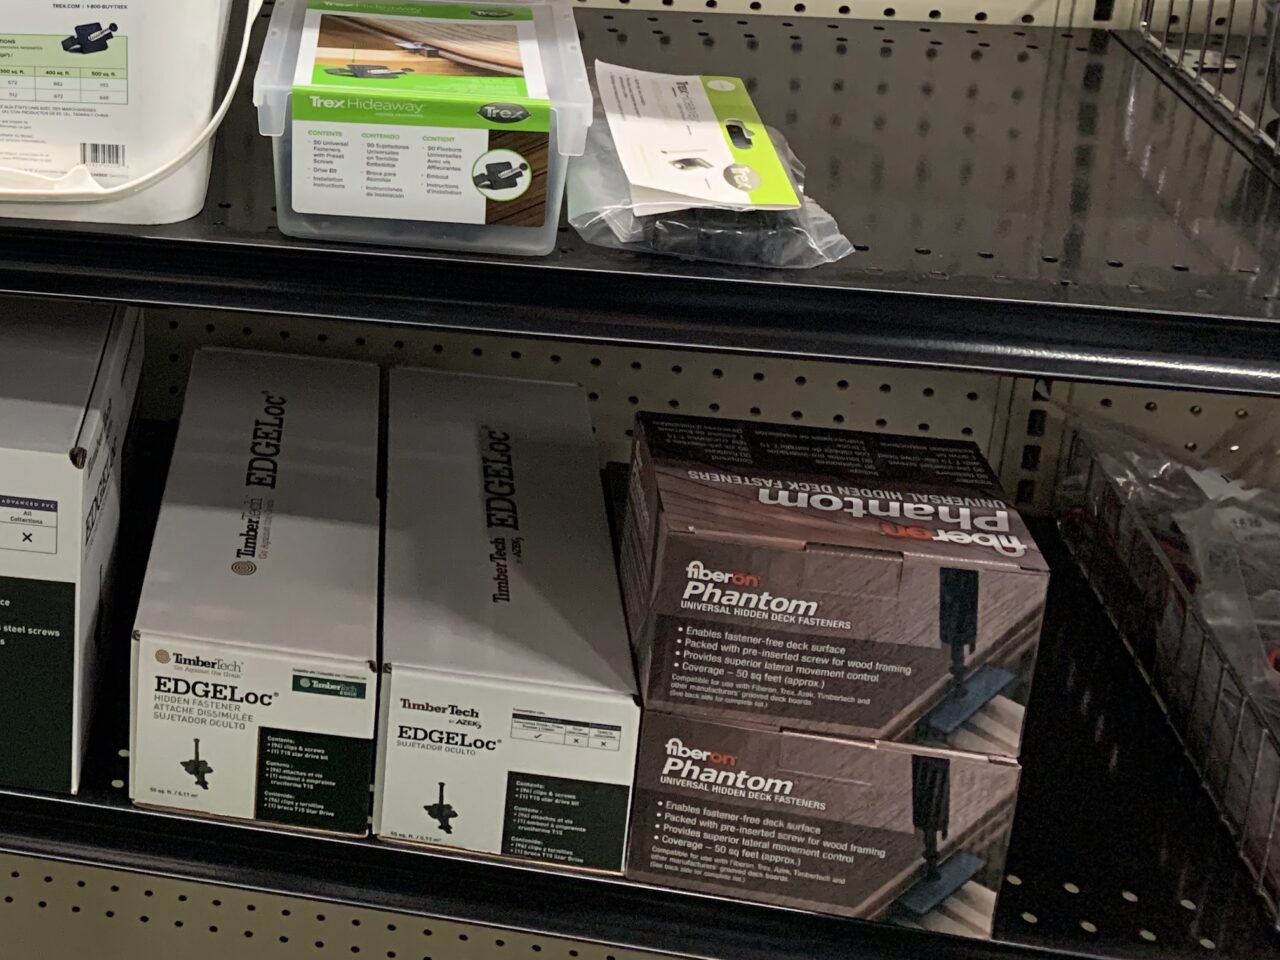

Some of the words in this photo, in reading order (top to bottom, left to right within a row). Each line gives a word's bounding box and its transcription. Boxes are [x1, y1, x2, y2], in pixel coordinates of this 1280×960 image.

[310, 96, 345, 109] Trex
[486, 106, 523, 119] Trex
[759, 488, 1009, 532] Phantom
[683, 581, 818, 616] Phantom
[680, 600, 730, 615] UNIVERSAL
[734, 608, 768, 621] HIDDEN
[770, 613, 795, 623] DECK
[798, 616, 851, 629] FASTENERS
[4, 623, 26, 634] steel
[28, 627, 60, 638] screws
[686, 626, 722, 639] Enables
[724, 631, 782, 648] fastener-free
[785, 638, 808, 649] deck
[811, 642, 846, 655] surface
[685, 639, 717, 652] Packed
[720, 642, 740, 654] with
[744, 646, 798, 664] pre-inserted
[800, 653, 829, 665] screw
[831, 656, 844, 667] for
[846, 658, 872, 671] wood
[875, 662, 911, 676] framing
[154, 695, 190, 706] HIDDEN
[192, 698, 241, 712] FASTENER
[154, 704, 195, 716] ATTACHE
[662, 758, 793, 794] Phantom
